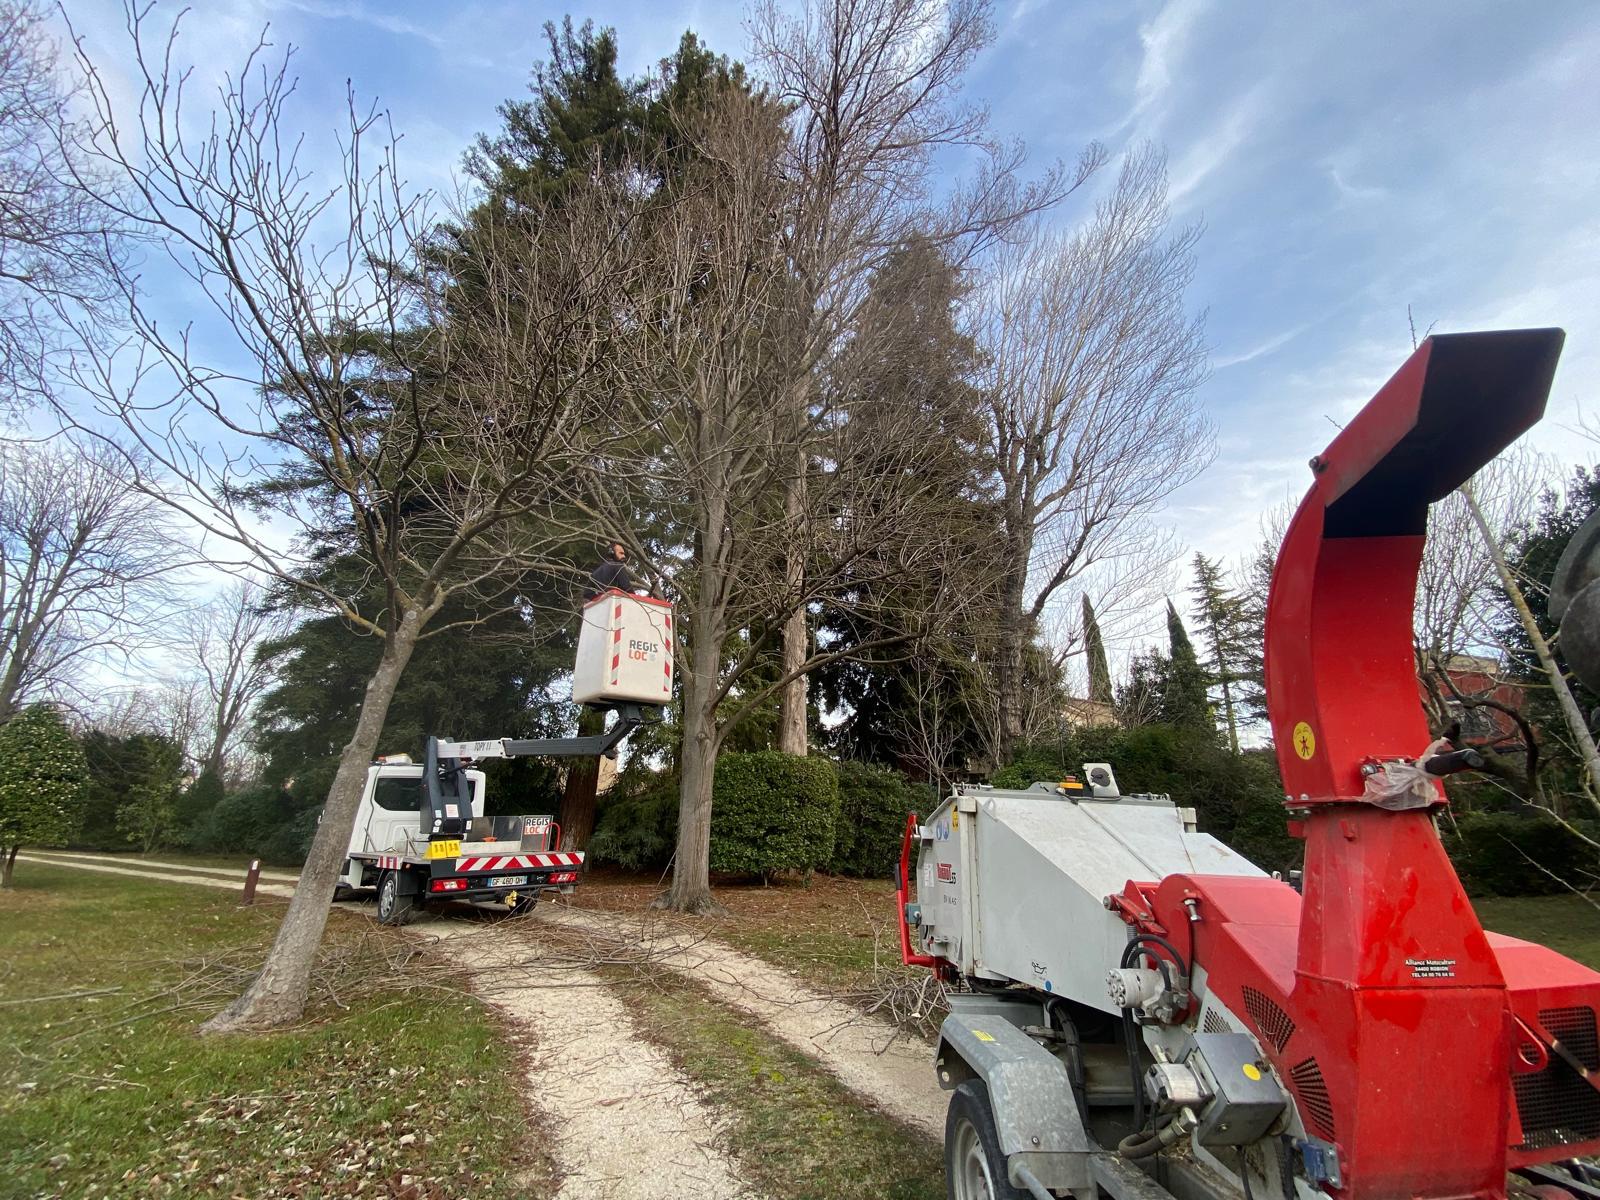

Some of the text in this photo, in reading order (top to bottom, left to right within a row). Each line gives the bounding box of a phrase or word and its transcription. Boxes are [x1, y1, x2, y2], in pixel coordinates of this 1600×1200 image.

[629, 639, 658, 653] REGIS
[629, 649, 648, 661] LOC
[526, 818, 549, 826] REGIS
[525, 826, 540, 834] LOC
[1405, 958, 1456, 966] Alliance Motoculture
